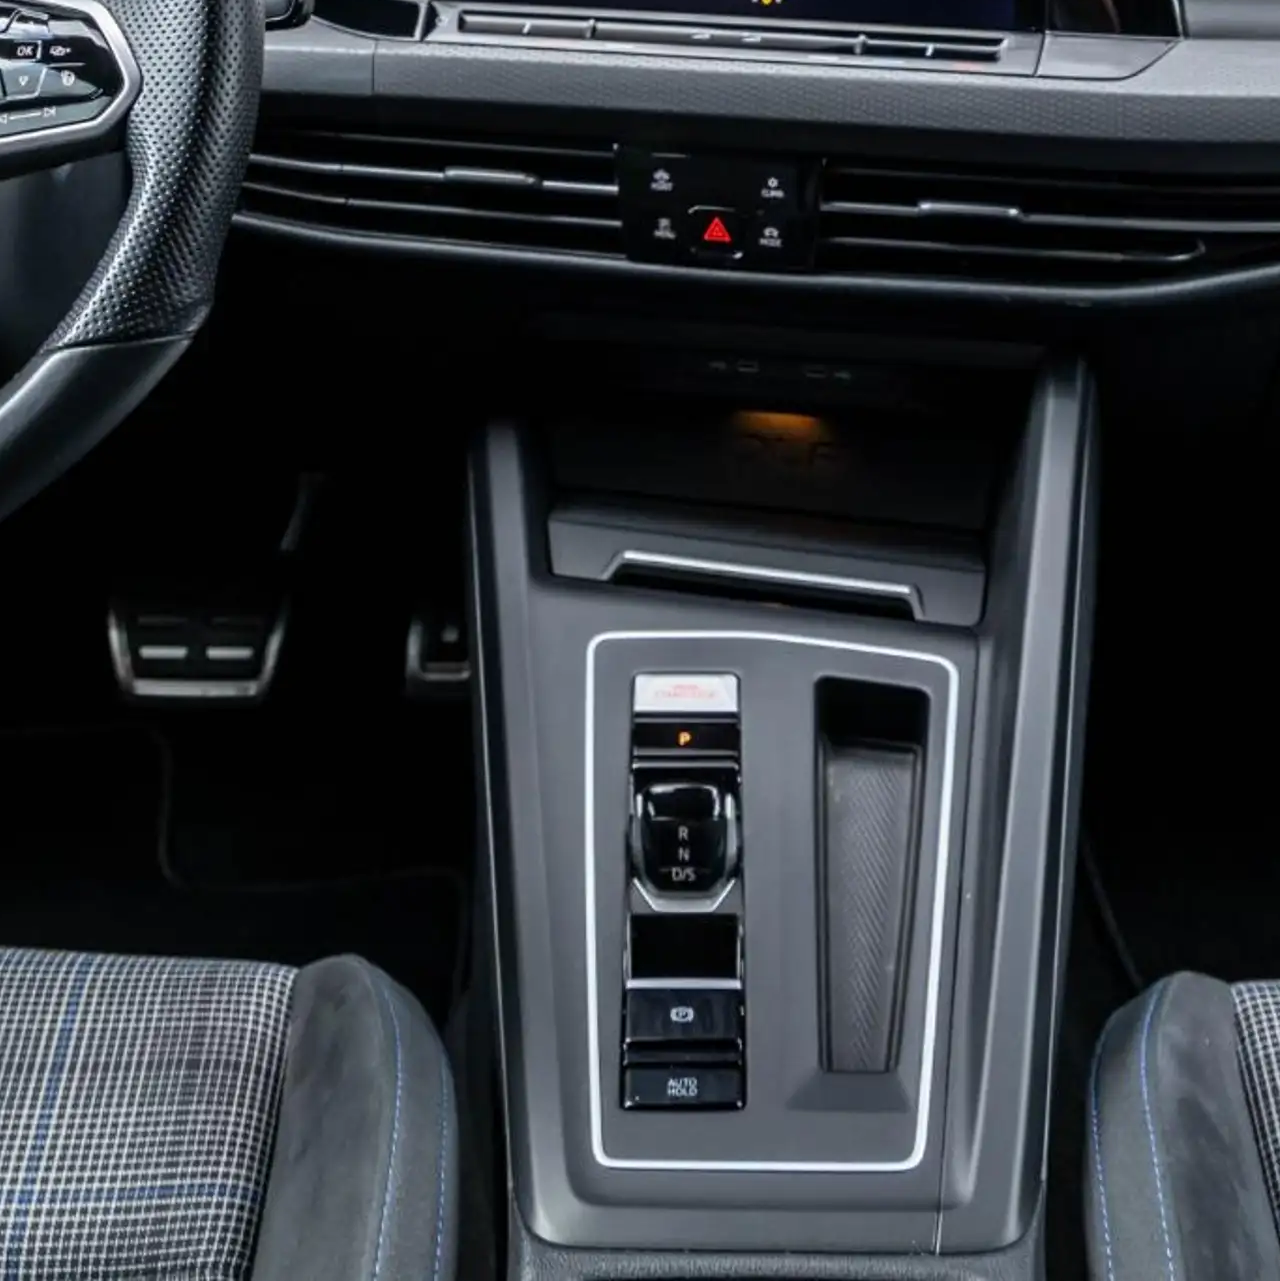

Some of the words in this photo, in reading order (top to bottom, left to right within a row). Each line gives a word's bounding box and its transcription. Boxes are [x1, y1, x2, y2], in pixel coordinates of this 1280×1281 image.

[16, 46, 34, 57] OK
[678, 730, 692, 746] P
[678, 825, 689, 841] R
[678, 847, 690, 862] N
[672, 867, 696, 882] D/S
[668, 1078, 698, 1088] AUTO
[668, 1087, 698, 1097] HOLD
